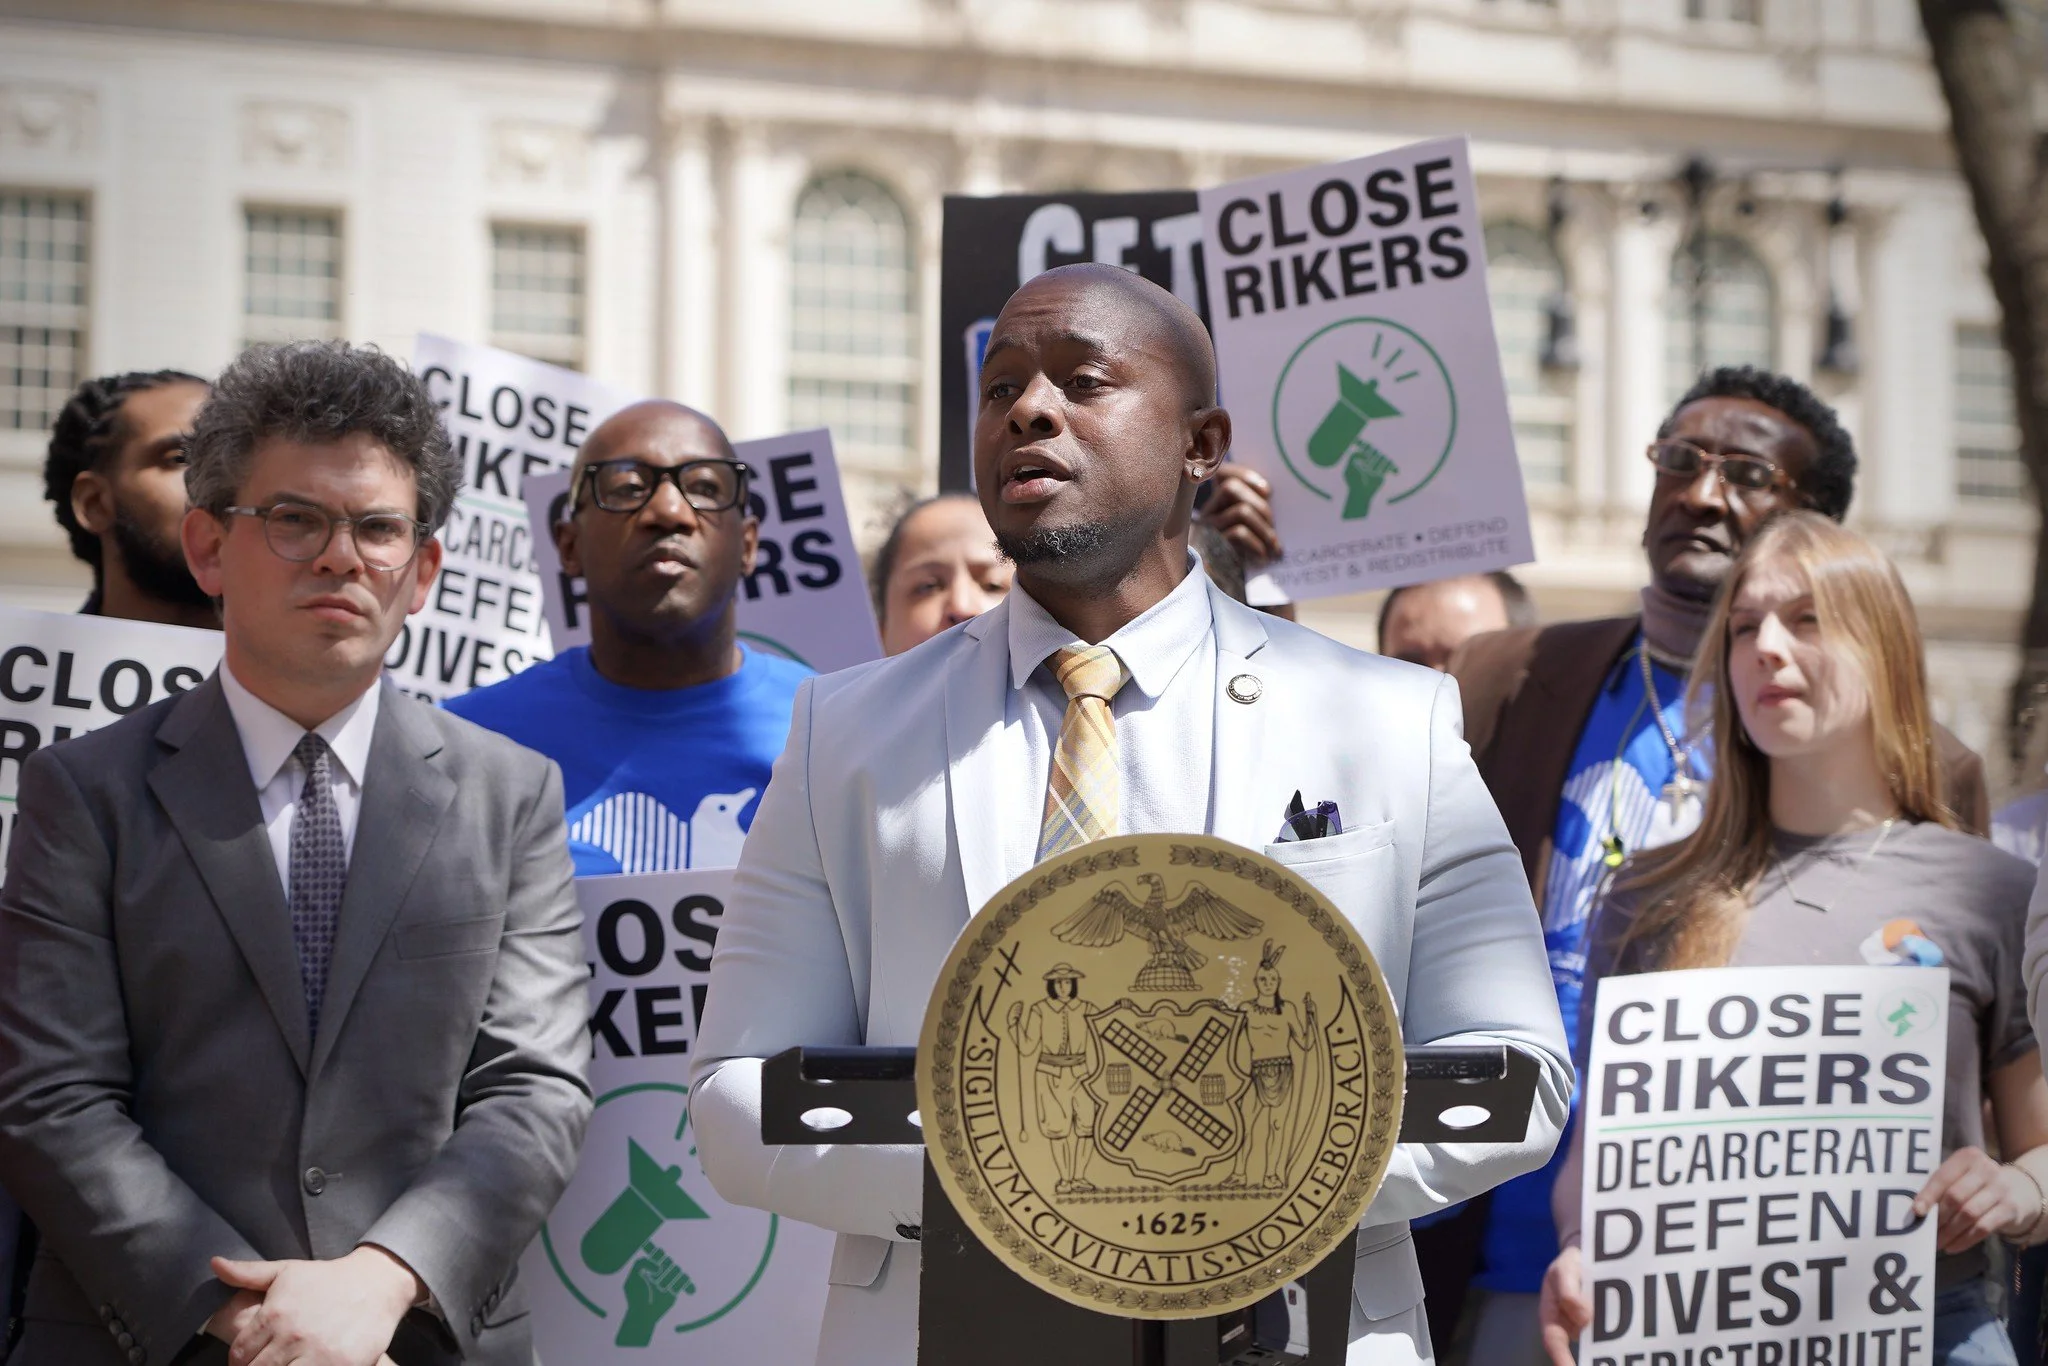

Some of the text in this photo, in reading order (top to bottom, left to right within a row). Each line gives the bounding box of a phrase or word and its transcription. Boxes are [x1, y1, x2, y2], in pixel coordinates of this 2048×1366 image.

[1217, 158, 1460, 256] CLOSE
[1224, 226, 1470, 319] RIKERS
[423, 366, 589, 448] CLOSE
[1279, 517, 1508, 564] ECARCERATE DEFEND
[1367, 538, 1509, 571] REDISTRIBUTE
[0, 645, 204, 716] CLOS
[1607, 993, 1863, 1046] CLOSE
[1600, 1053, 1932, 1117] RIKERS
[1031, 1211, 1225, 1283] CIVITATIS
[1231, 1196, 1322, 1269] NOVI
[1311, 1040, 1364, 1190] EBORACI
[1598, 1128, 1931, 1193] DECARCERATE
[1135, 1210, 1206, 1236] 1625
[1593, 1188, 1928, 1263] DEFEND
[1592, 1252, 1923, 1344] DIVEST &
